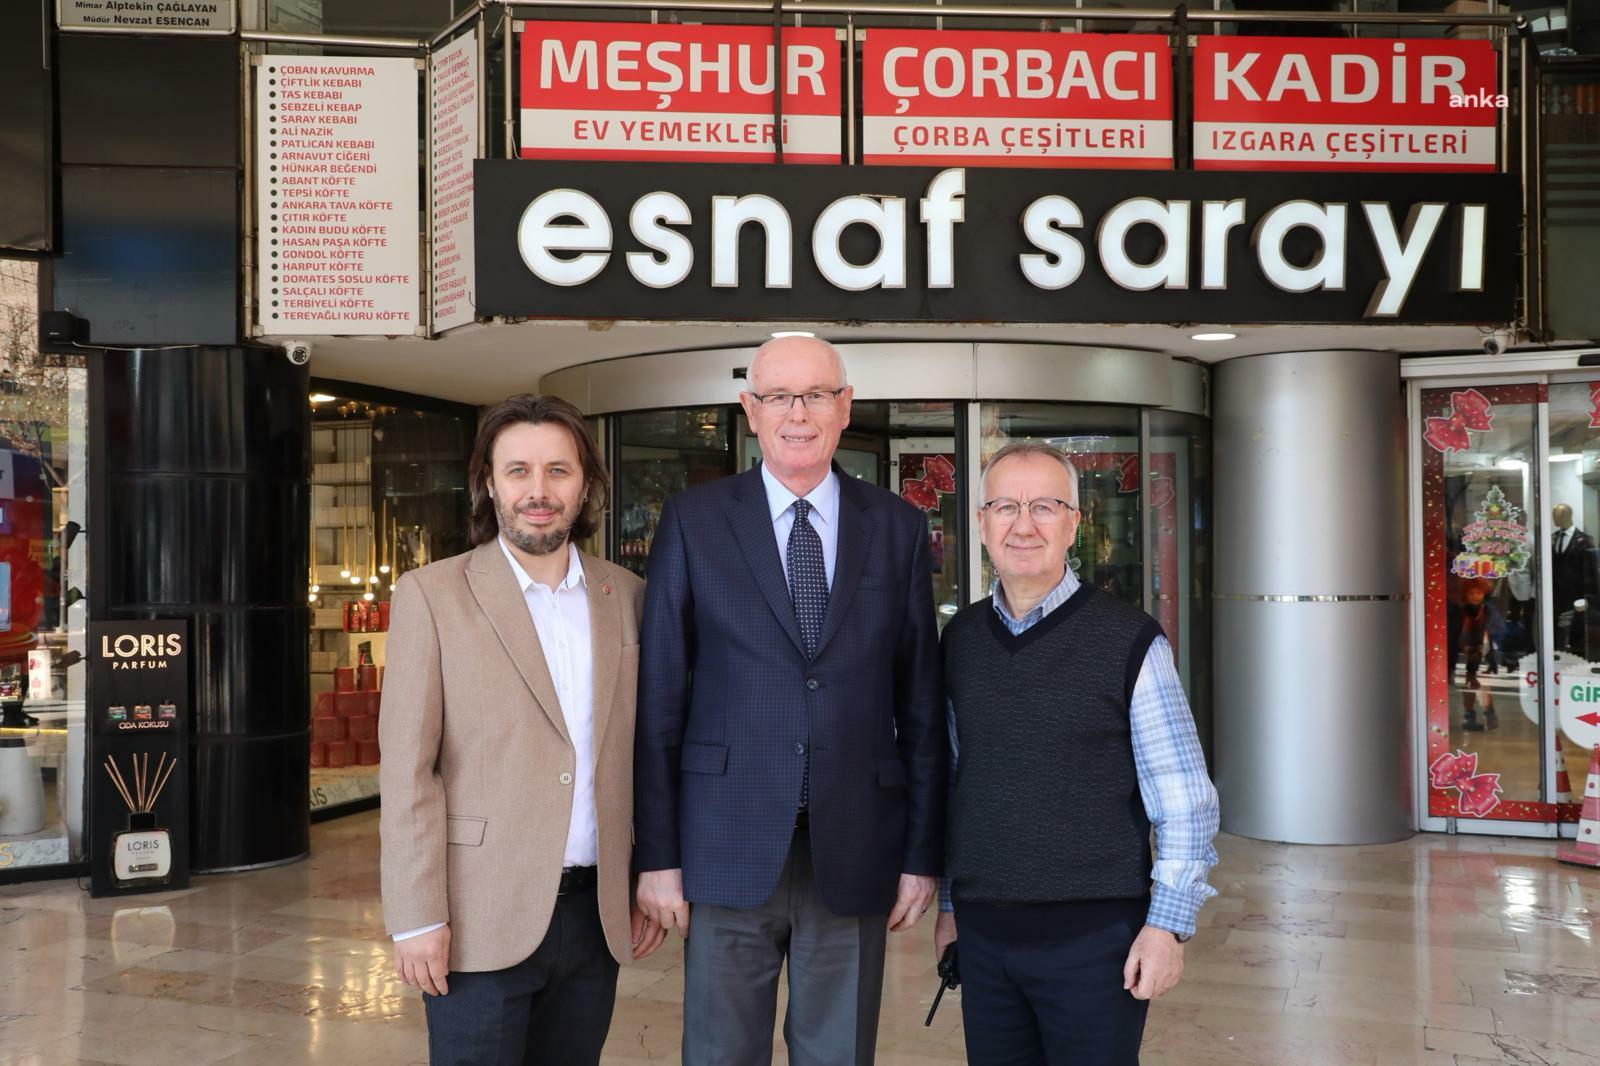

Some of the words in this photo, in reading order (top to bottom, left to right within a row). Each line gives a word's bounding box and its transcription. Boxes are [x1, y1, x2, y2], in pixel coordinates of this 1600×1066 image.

[75, 1, 102, 9] Mimar
[106, 0, 153, 11] Alptekin
[157, 1, 217, 14] ÇAĞLAYAN
[84, 15, 110, 23] Müdür
[113, 15, 153, 25] Nevzat
[156, 16, 210, 26] ESENCAN
[280, 66, 318, 77] ÇOBAN
[320, 66, 374, 76] KAVURMA
[539, 39, 826, 109] MEŞHUR
[1213, 42, 1467, 105] KADİR
[280, 78, 320, 88] ÇİFTLİK
[323, 79, 362, 88] KEBABI
[882, 46, 1156, 114] ÇORBACI
[281, 90, 300, 99] TAS
[304, 91, 342, 100] KEBABI
[281, 102, 324, 111] SEBZELİ
[327, 103, 362, 112] KEBAP
[281, 115, 316, 124] SARAY
[318, 116, 357, 124] KEBABI
[281, 126, 298, 136] ALİ
[300, 127, 333, 136] NAZİK
[573, 119, 609, 140] EV
[620, 119, 788, 145] YEMEKLERİ
[894, 124, 990, 153] ÇORBA
[1001, 123, 1146, 154] ÇEŞİTLERİ
[1212, 130, 1315, 152] IZGARA
[1325, 128, 1468, 159] ÇEŞİTLERİ
[281, 140, 333, 148] PATLICAN
[336, 140, 374, 149] KEBABI
[281, 152, 334, 160] ARNAVUT
[336, 151, 370, 161] CİĞERİ
[282, 163, 327, 172] HÜNKAR
[330, 164, 377, 173] BEĞENDİ
[282, 176, 319, 185] ABANT
[322, 175, 356, 185] KÖFTE
[282, 188, 312, 197] TEPSİ
[315, 188, 349, 197] KÖFTE
[282, 201, 327, 210] ANKARA
[329, 201, 357, 210] TAVA
[359, 200, 393, 210] KÖFTE
[282, 214, 310, 224] ÇITIR
[312, 212, 347, 222] KÖFTE
[282, 226, 316, 234] KADIN
[319, 226, 349, 234] BUDU
[352, 224, 386, 234] KÖFTE
[282, 238, 320, 246] HASAN
[322, 238, 350, 249] PAŞA
[353, 237, 387, 247] KÖFTE
[517, 167, 966, 292] esnaf
[1019, 194, 1487, 318] sarayı
[282, 250, 327, 259] GONDOL
[330, 249, 364, 259] KÖFTE
[282, 263, 327, 271] HARPUT
[329, 262, 363, 271] KÖFTE
[283, 275, 335, 283] DOMATES
[338, 275, 372, 283] SOSLU
[375, 274, 410, 283] KÖFTE
[283, 287, 326, 298] SALÇALI
[329, 286, 363, 296] KÖFTE
[283, 298, 337, 308] TERBİYELİ
[340, 298, 374, 308] KÖFTE
[283, 310, 340, 320] TEREYAĞLI
[344, 312, 373, 320] KURU
[376, 310, 410, 320] KÖFTE
[102, 633, 182, 659] LORIS
[112, 660, 168, 670] PARFUM
[118, 722, 137, 730] ODA
[138, 720, 169, 728] KOKUSU
[127, 840, 160, 851] LORIS
